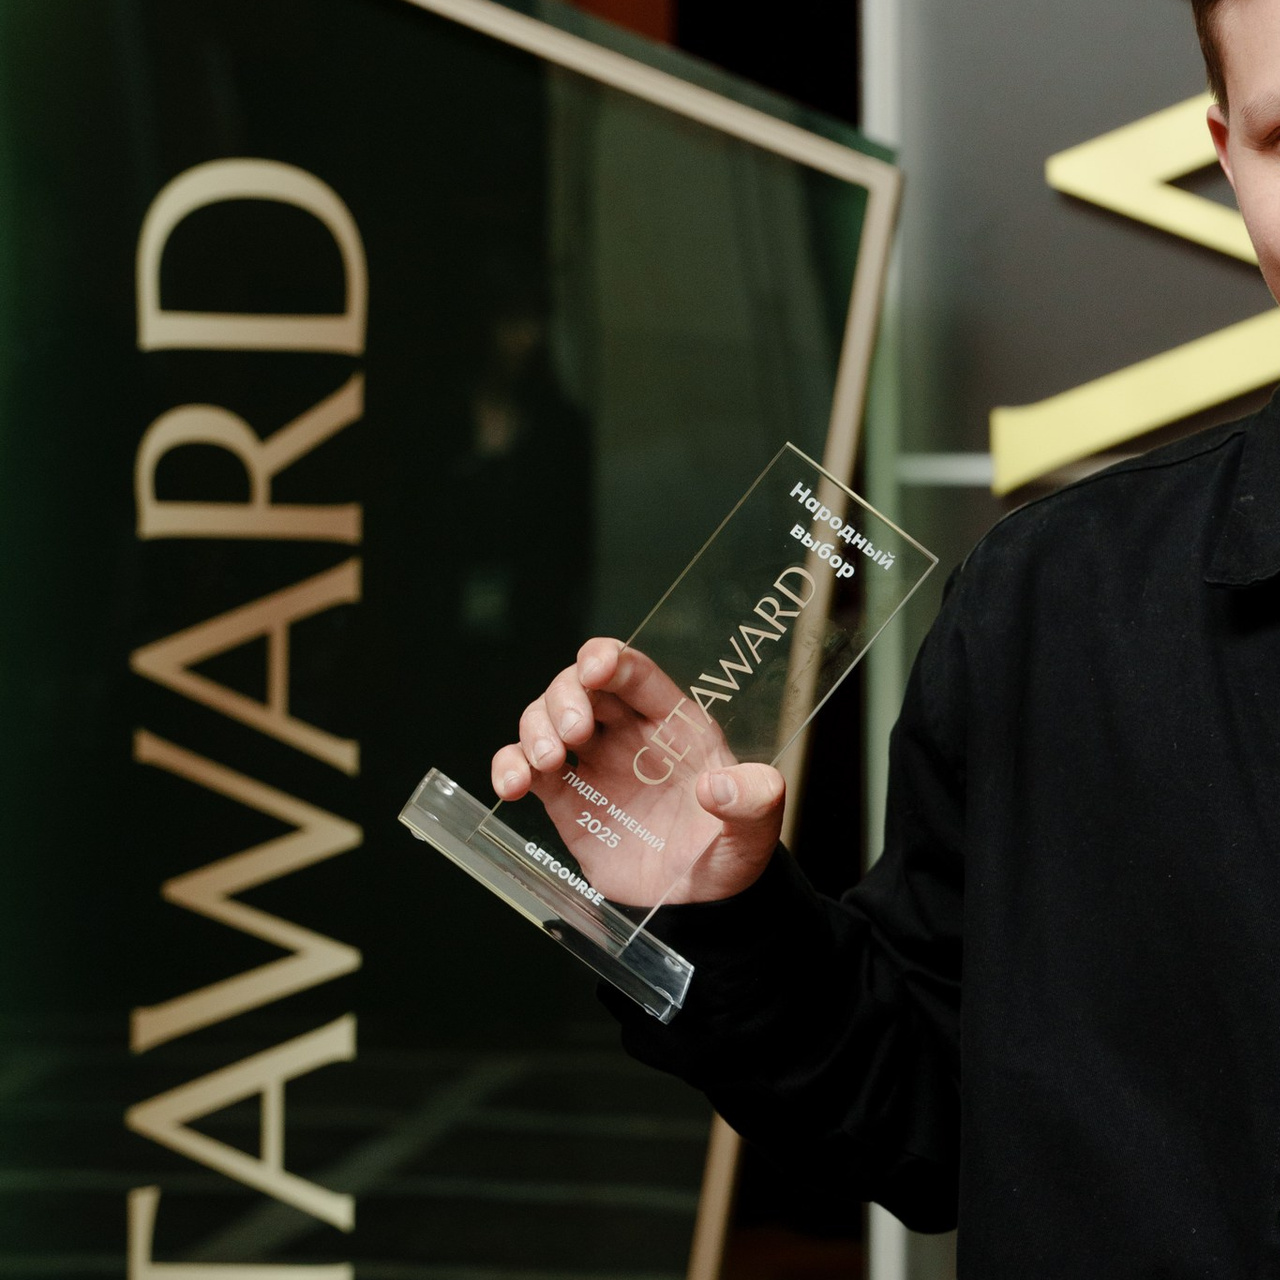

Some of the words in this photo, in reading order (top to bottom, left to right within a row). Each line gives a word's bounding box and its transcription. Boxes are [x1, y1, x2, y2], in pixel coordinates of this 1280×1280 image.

[789, 481, 896, 571] Народный
[789, 524, 855, 578] выбор
[633, 566, 816, 786] GETAWARD
[562, 771, 608, 807] ЛИДЕР
[606, 804, 666, 852] МНЕНИЙ
[576, 811, 621, 849] 2025
[524, 841, 605, 906] GETCOURSE
